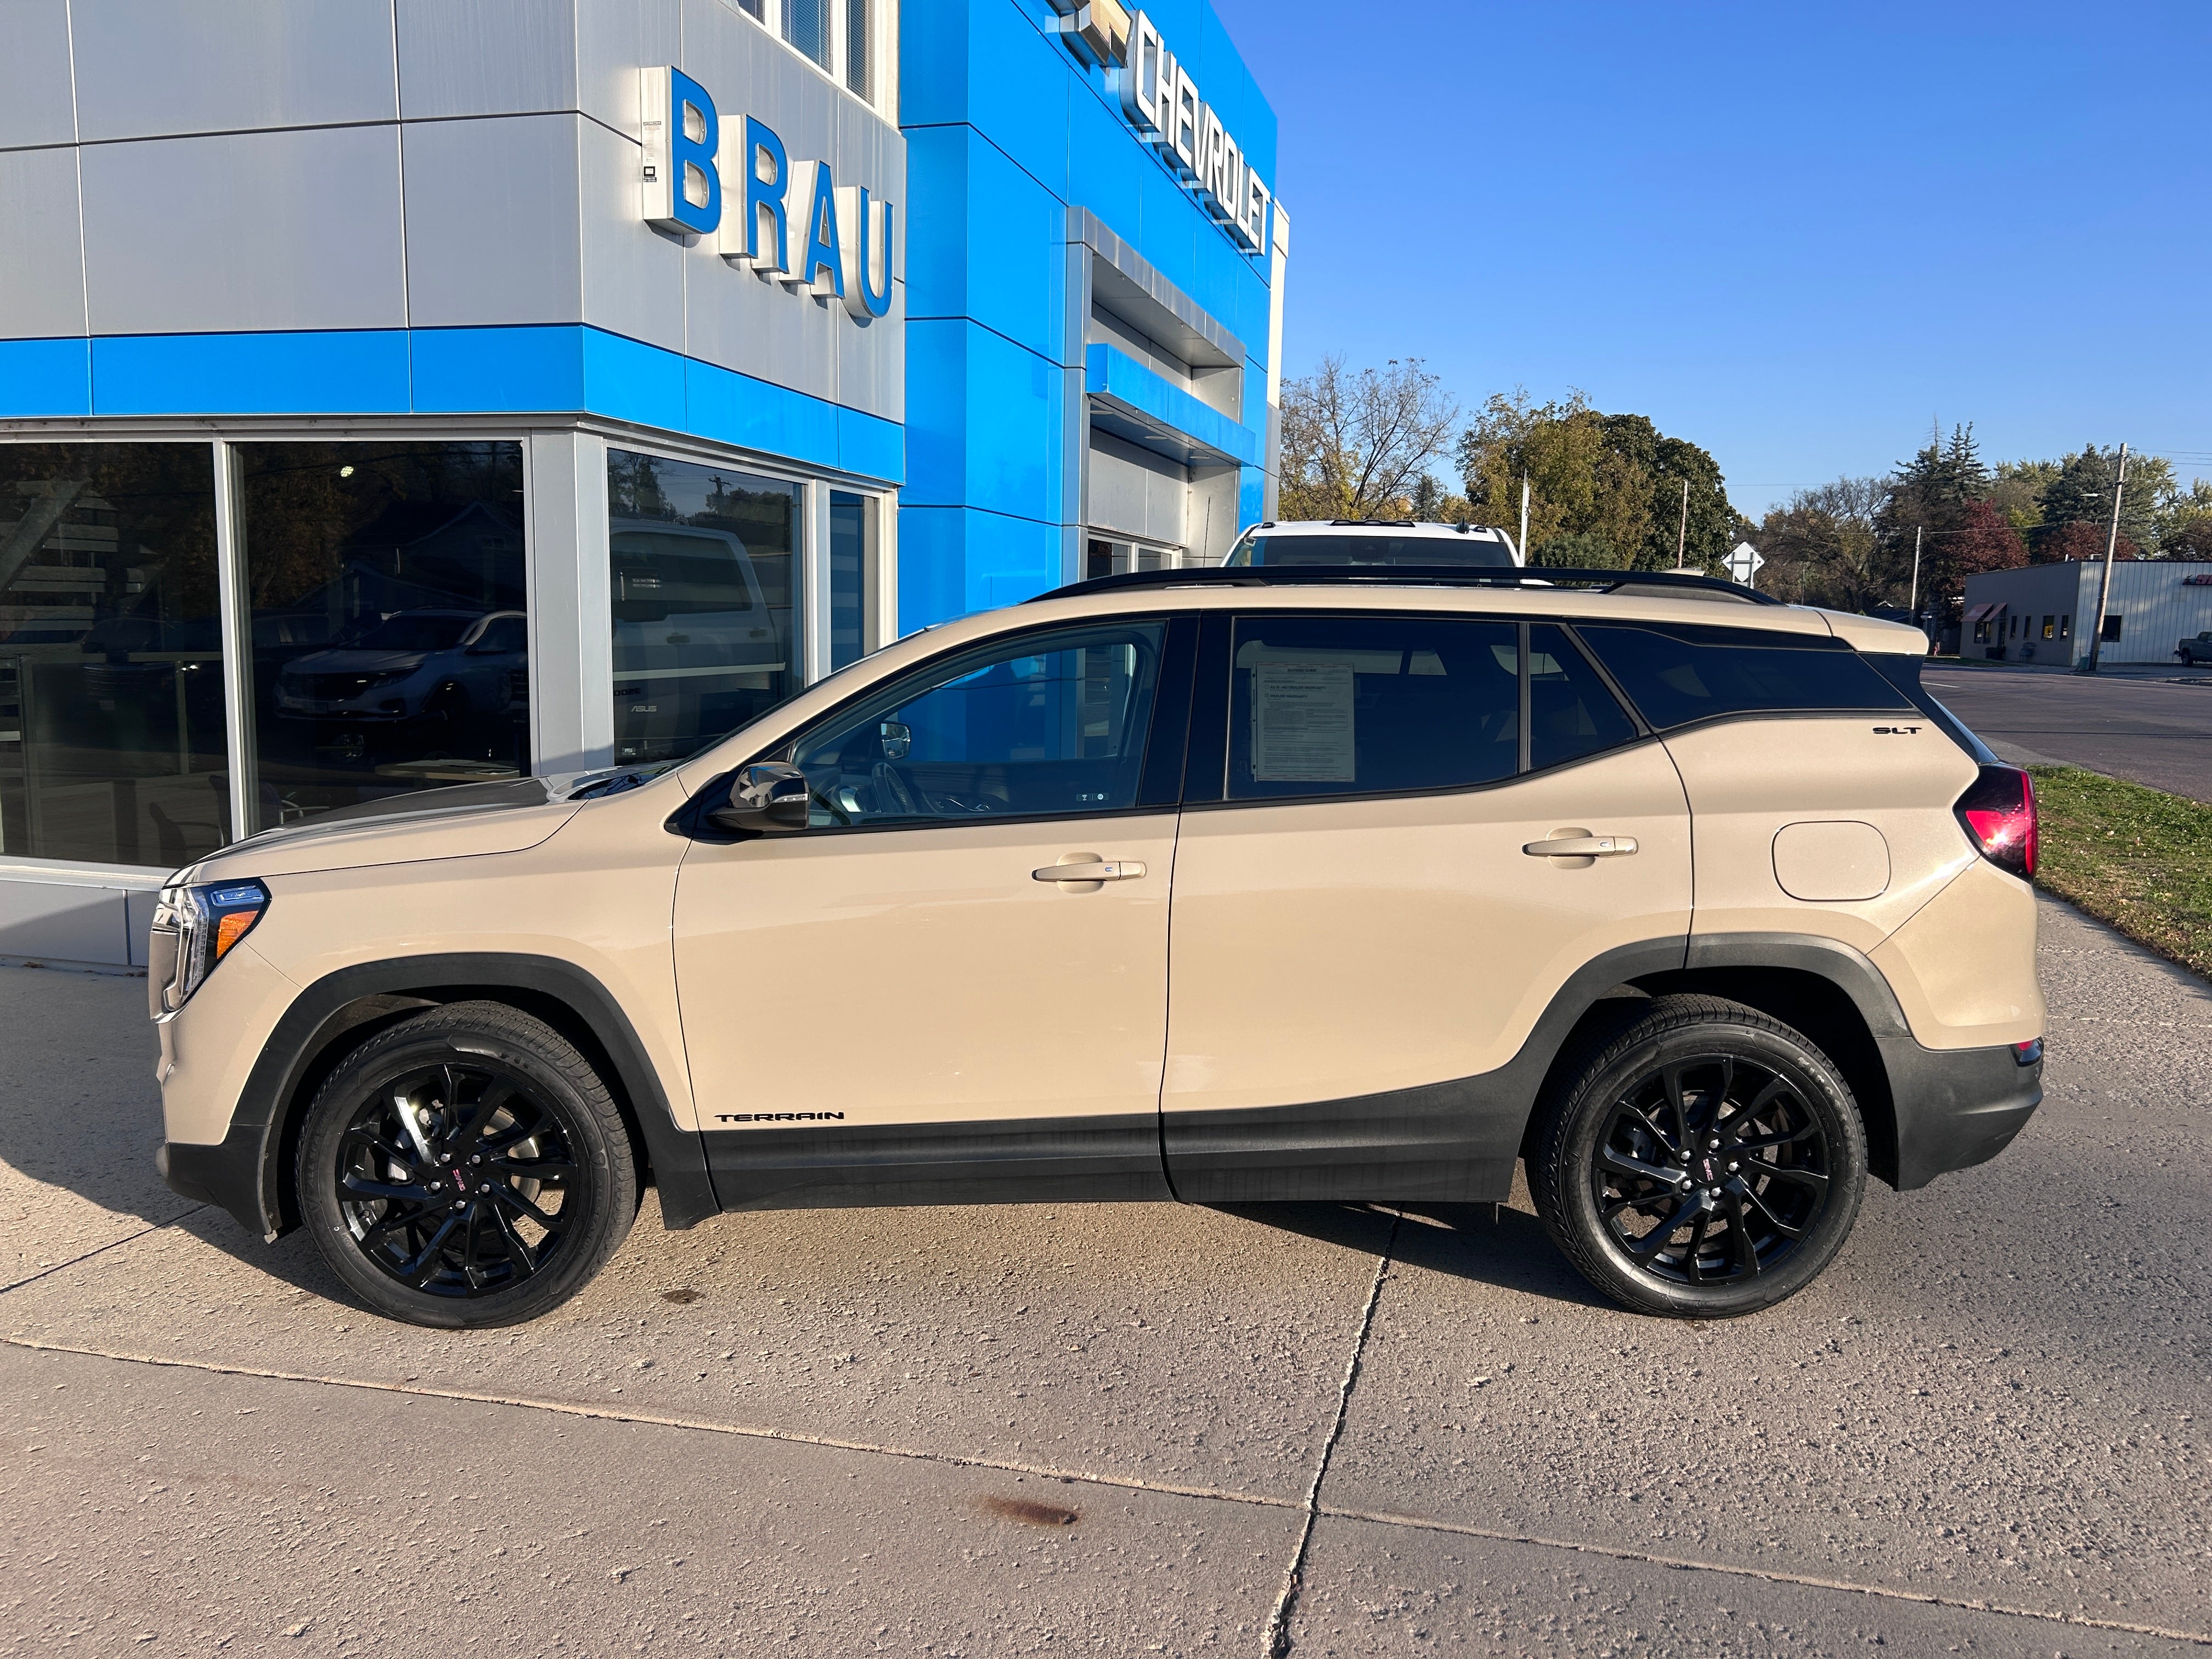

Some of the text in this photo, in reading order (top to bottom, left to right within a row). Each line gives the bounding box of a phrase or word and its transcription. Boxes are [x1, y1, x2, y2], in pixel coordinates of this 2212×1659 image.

[670, 65, 894, 318] BRAU
[1136, 9, 1271, 257] CHEVROLET
[714, 1111, 845, 1122] TERRAIN
